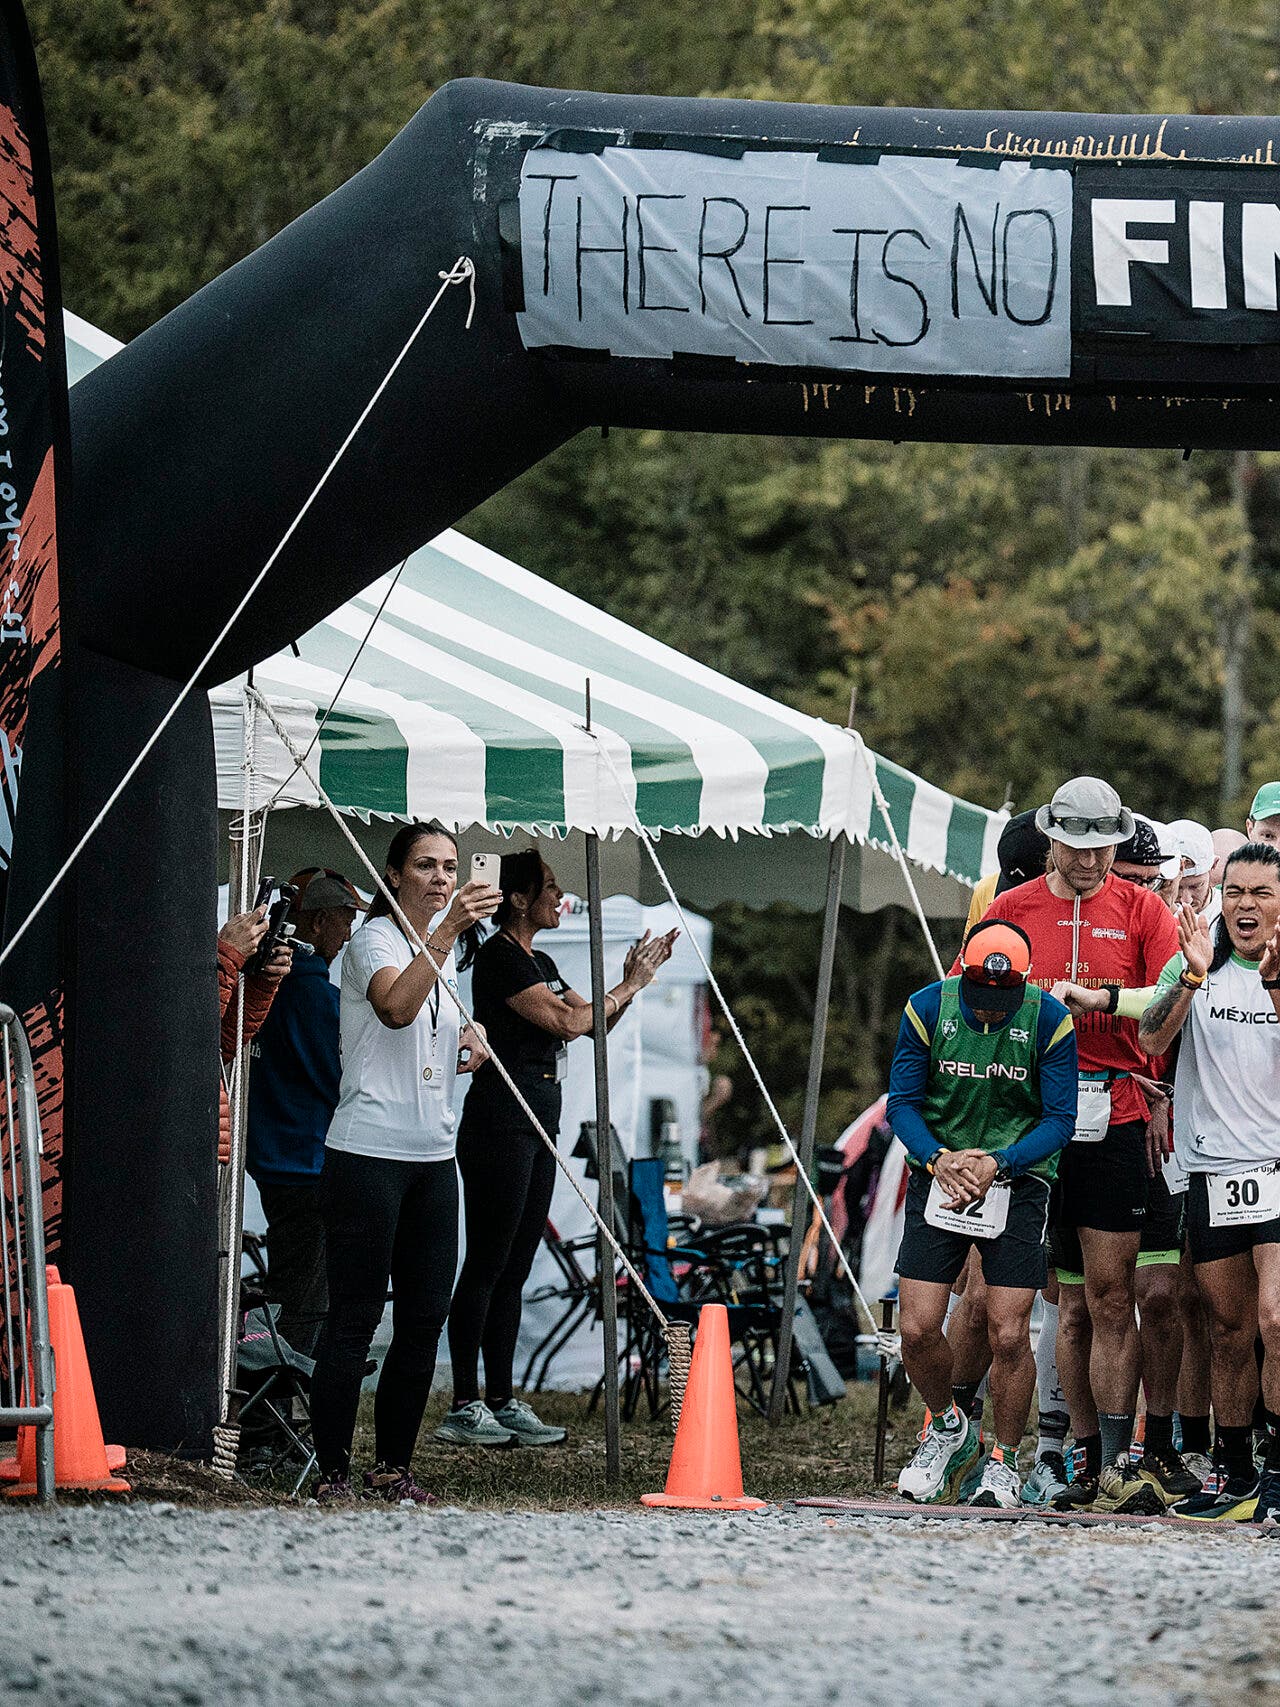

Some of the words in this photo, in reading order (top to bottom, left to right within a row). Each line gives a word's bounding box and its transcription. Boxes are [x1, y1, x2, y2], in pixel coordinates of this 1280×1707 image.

[526, 174, 814, 325] THERE
[829, 227, 932, 348] IS
[950, 202, 1058, 326] NO
[1065, 962, 1090, 973] 225
[1209, 1006, 1280, 1025] MÉXICO
[938, 1060, 1028, 1081] IRELAND
[1225, 1179, 1260, 1208] 30
